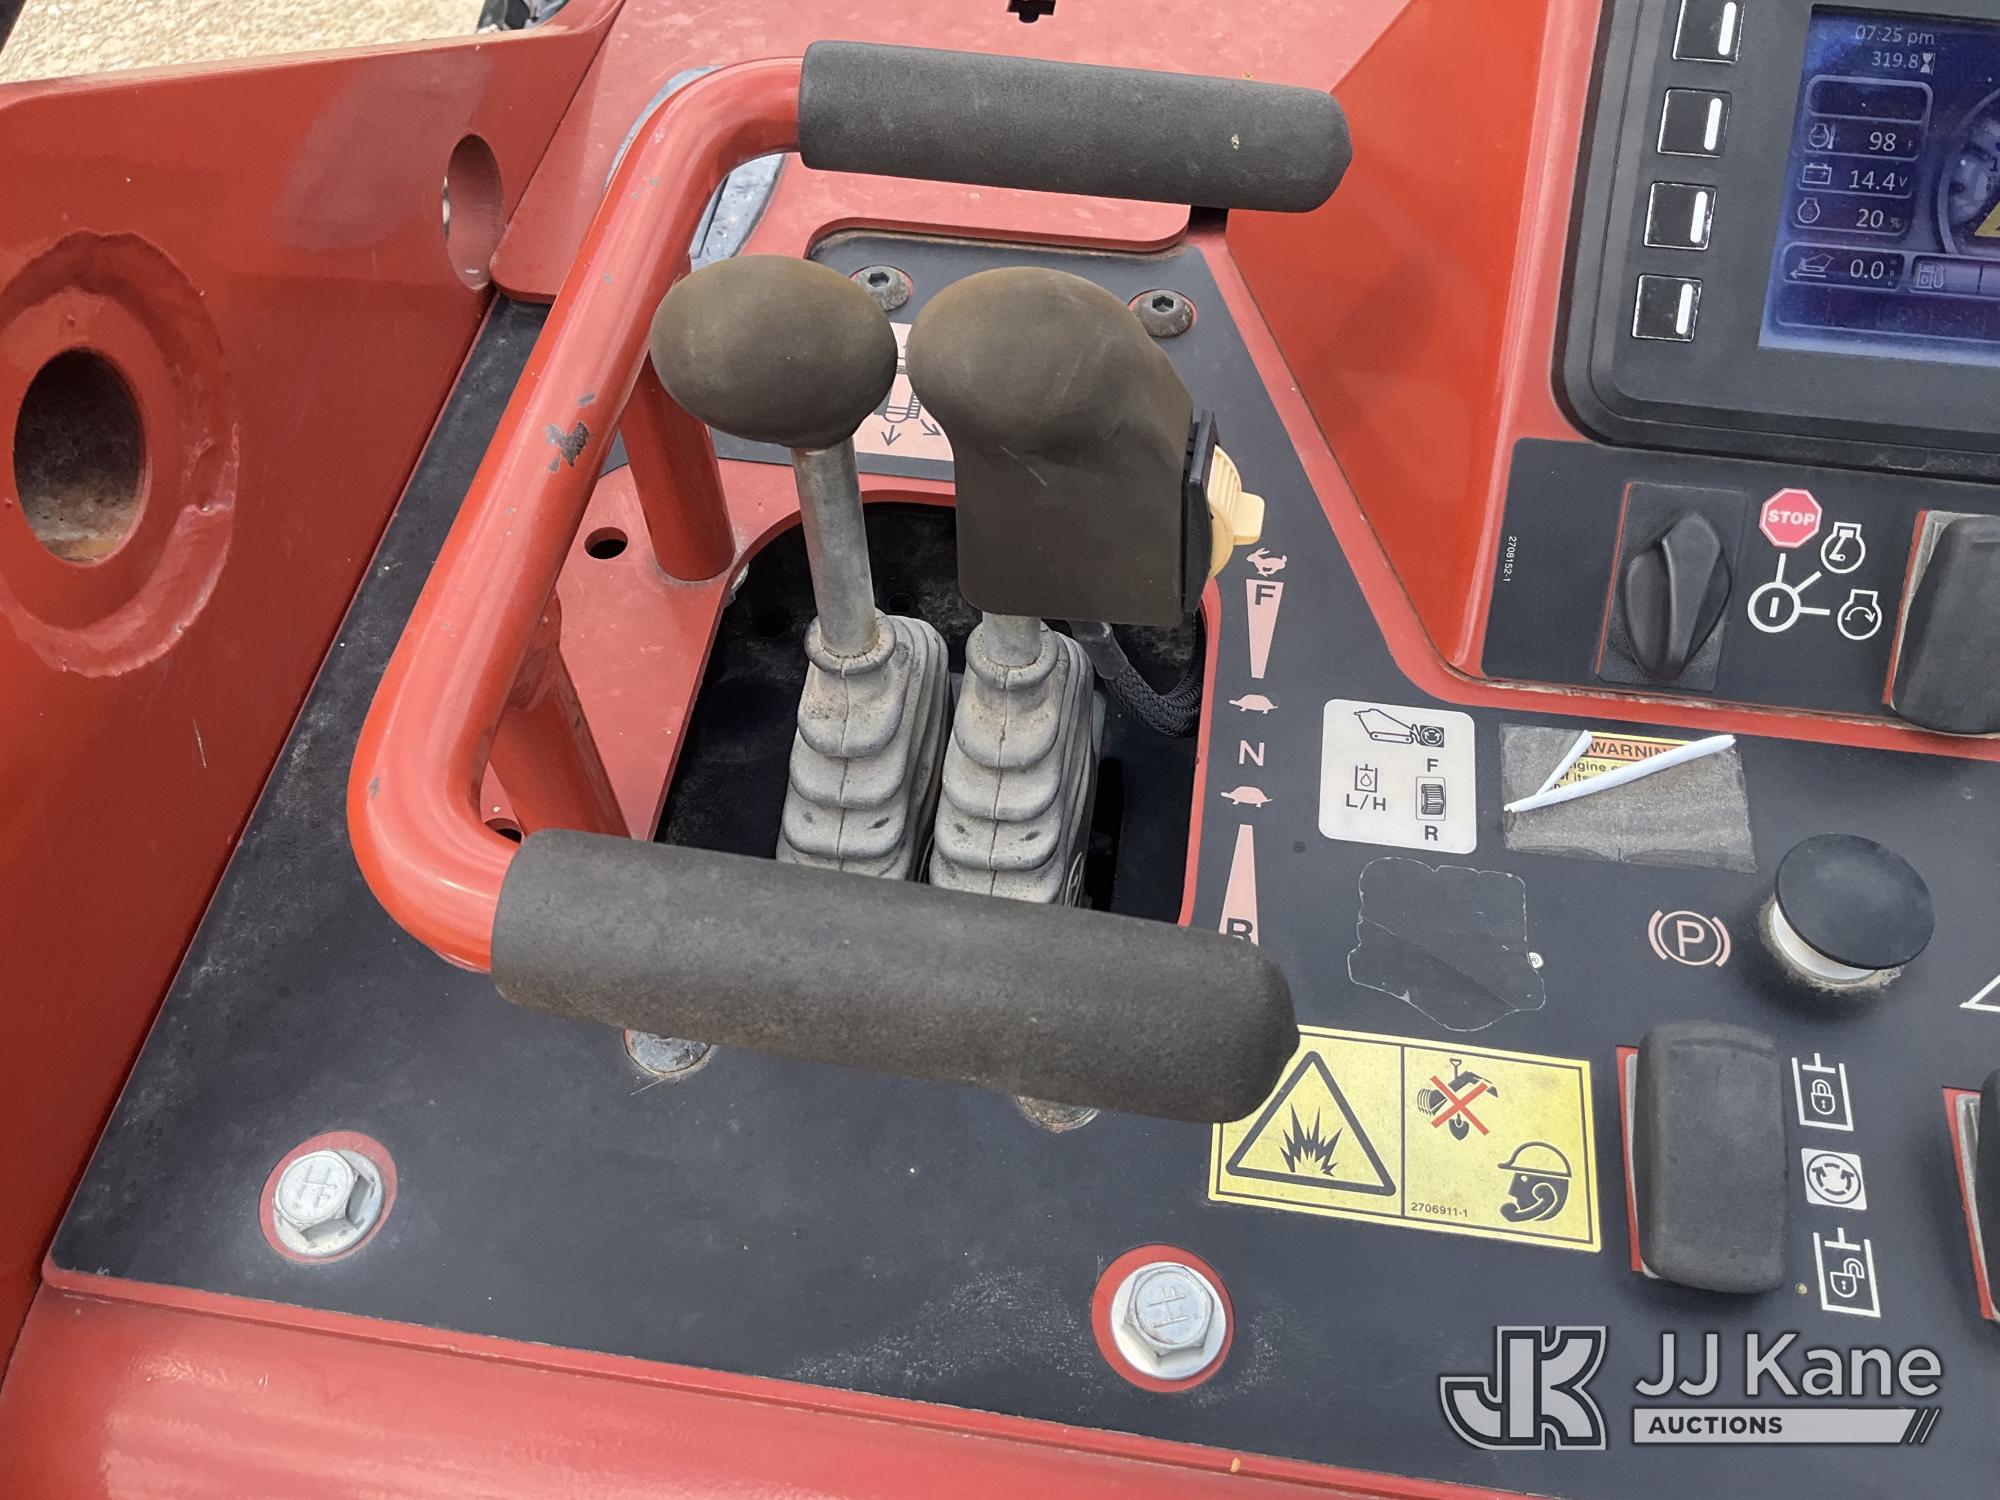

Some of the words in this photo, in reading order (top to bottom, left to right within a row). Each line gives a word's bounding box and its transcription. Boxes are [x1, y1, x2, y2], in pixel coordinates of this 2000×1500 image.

[1855, 24, 1903, 43] 07:25
[1907, 32, 1935, 47] pm
[1871, 50, 1919, 69] 319.8
[1869, 131, 1897, 152] 98
[1848, 170, 1895, 191] 14.4
[1856, 208, 1884, 228] 20
[1850, 259, 1885, 280] 0.0
[1767, 508, 1816, 526] STOP
[1502, 535, 1518, 582] 2708152-1
[1254, 584, 1276, 606] F
[1238, 740, 1265, 767] N
[1427, 758, 1439, 772] F
[1345, 793, 1386, 811] L/H
[1424, 824, 1439, 841] R
[1676, 919, 1705, 957] P
[1410, 1201, 1468, 1218] 2706911-1
